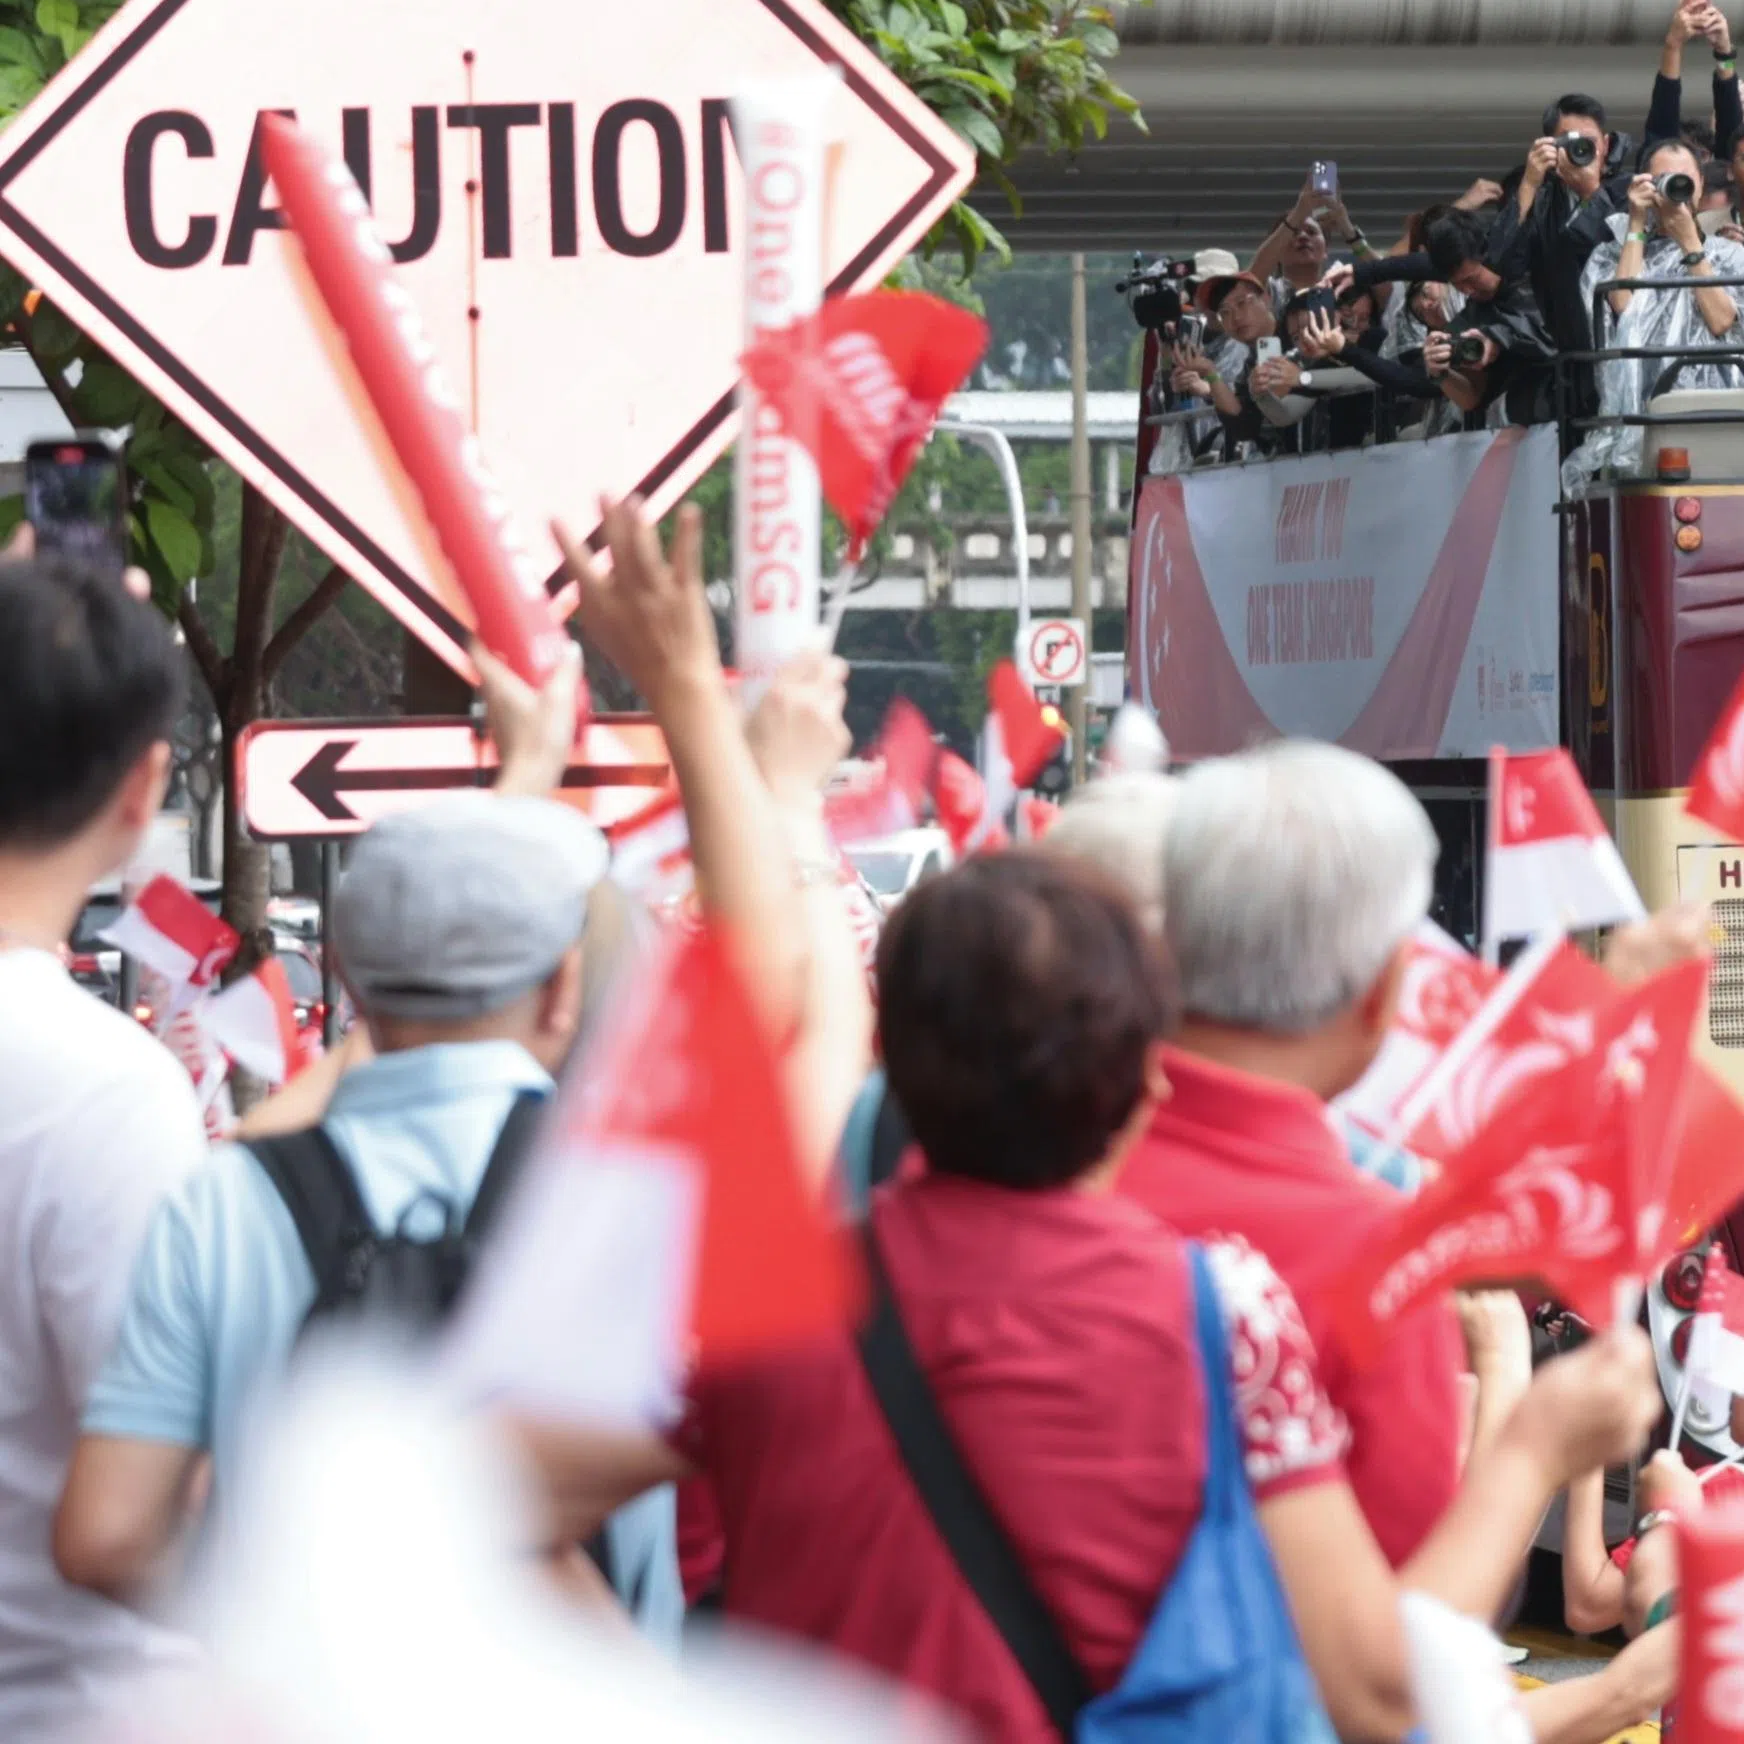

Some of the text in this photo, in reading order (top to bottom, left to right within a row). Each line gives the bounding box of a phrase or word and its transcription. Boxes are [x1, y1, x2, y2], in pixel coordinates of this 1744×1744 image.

[1276, 477, 1351, 566] THANK YOU
[1272, 582, 1304, 664] TEAM
[1306, 576, 1375, 662] SINGAPORE
